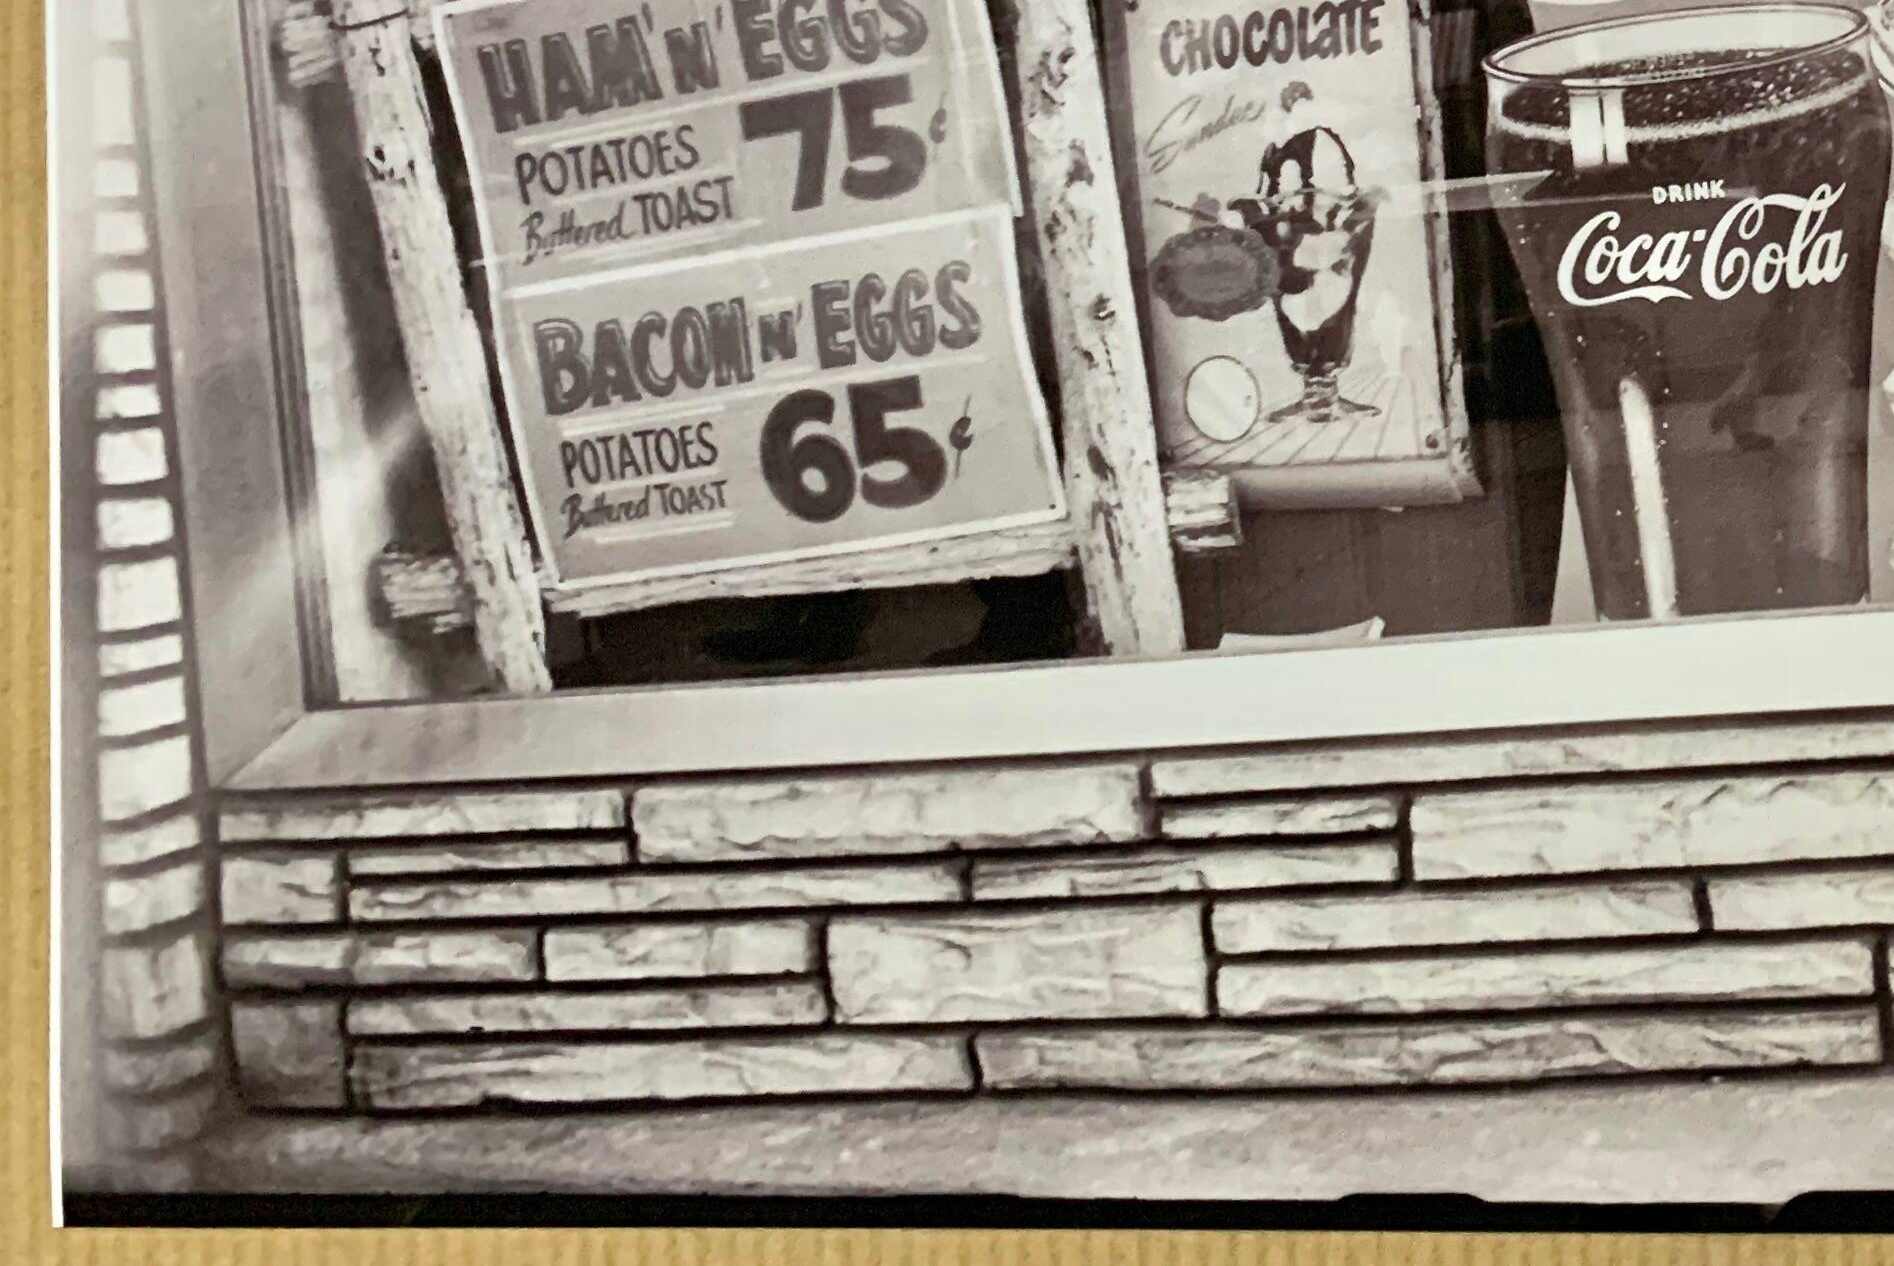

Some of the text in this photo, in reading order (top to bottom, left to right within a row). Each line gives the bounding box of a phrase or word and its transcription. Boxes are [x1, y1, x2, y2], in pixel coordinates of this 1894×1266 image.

[514, 124, 700, 205] POTATOES
[1652, 179, 1727, 205] DRINK
[520, 175, 734, 266] Buttered TOAST
[1557, 182, 1849, 307] Coca-Cola
[561, 422, 718, 488] POTATOES
[560, 478, 728, 540] Buttered TOAST
